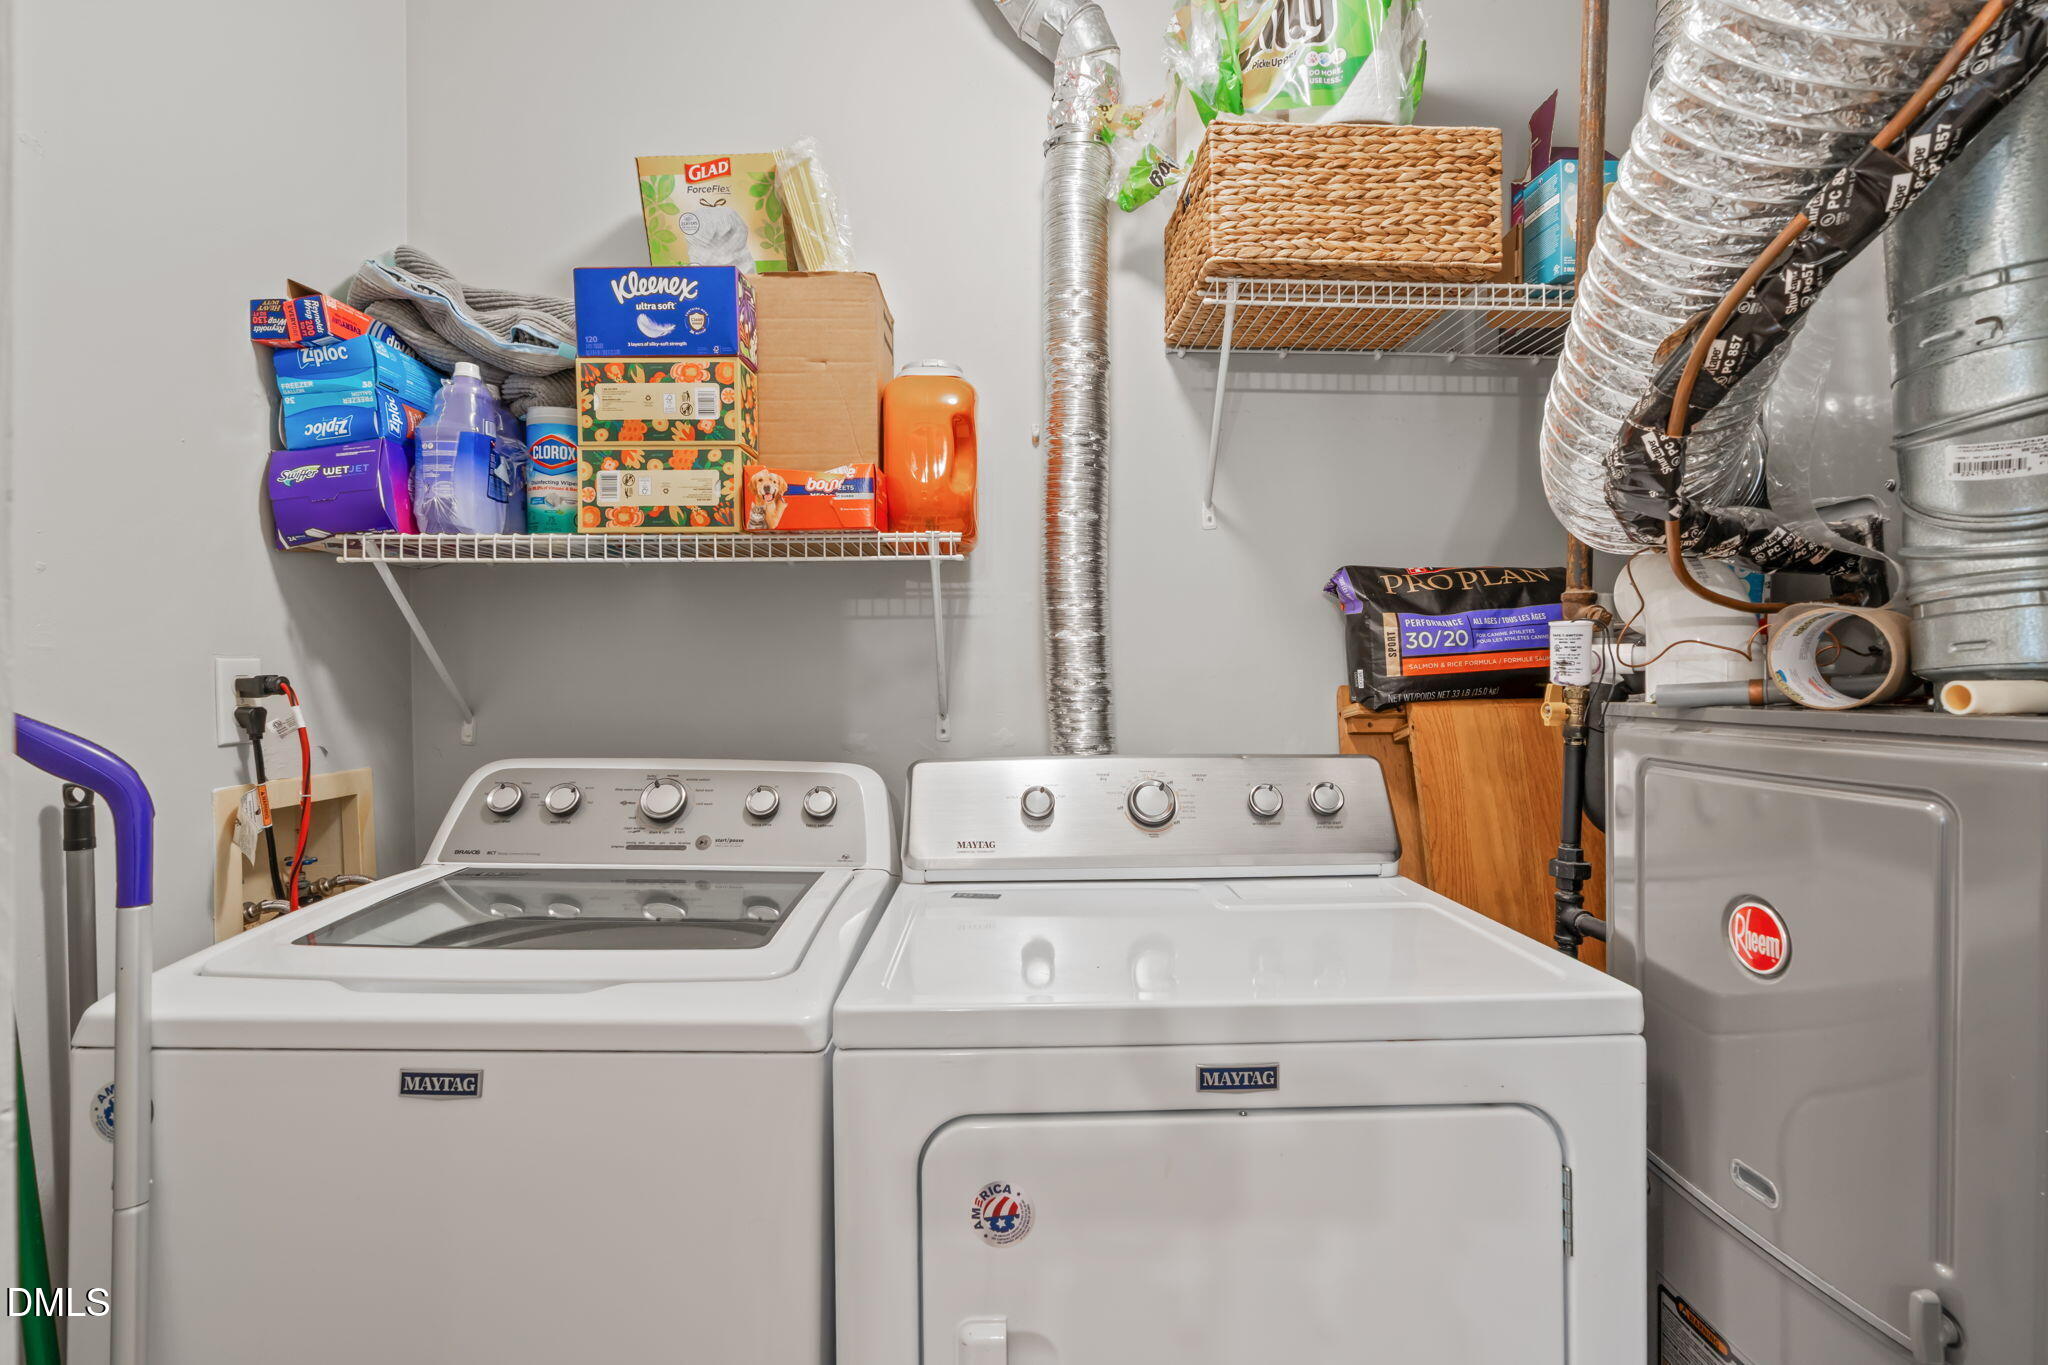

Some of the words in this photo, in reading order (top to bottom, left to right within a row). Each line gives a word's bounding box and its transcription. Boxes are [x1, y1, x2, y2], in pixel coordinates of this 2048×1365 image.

[1934, 123, 1952, 152] 857
[688, 161, 729, 182] GLAD
[686, 185, 732, 194] ForceFlex
[1826, 189, 1843, 210] PC
[611, 270, 699, 304] Kleenex
[304, 300, 313, 320] Wrap
[635, 301, 656, 311] ultra
[657, 301, 677, 311] soft
[268, 316, 287, 326] Wrap
[311, 300, 324, 334] Reynolds
[253, 324, 286, 334] Reynolds
[1727, 335, 1743, 357] 857
[300, 346, 348, 366] Ziploc
[386, 394, 403, 434] Ziploc
[304, 416, 348, 436] Ziploc
[532, 446, 576, 460] CLOROX
[276, 469, 319, 483] Swiffer
[1766, 544, 1782, 556] PC
[1380, 573, 1453, 595] PRO
[1455, 568, 1551, 591] PLAN
[1404, 618, 1464, 628] PERFORMANCE
[1472, 617, 1484, 625] ALL
[1484, 616, 1498, 624] AGES
[1502, 614, 1518, 624] TOUS
[1518, 614, 1530, 622] LES
[1388, 632, 1397, 658] SPORT
[1405, 630, 1469, 649] 30/20
[1388, 694, 1401, 703] NET
[1437, 690, 1450, 699] NET
[1452, 690, 1461, 698] 33
[1462, 688, 1470, 696] LB
[956, 840, 996, 849] MAYTAG
[1734, 908, 1780, 960] Rheem
[403, 1076, 477, 1092] MAYTAG
[1202, 1070, 1275, 1086] MAYTAG
[972, 1184, 1012, 1230] AMERICA
